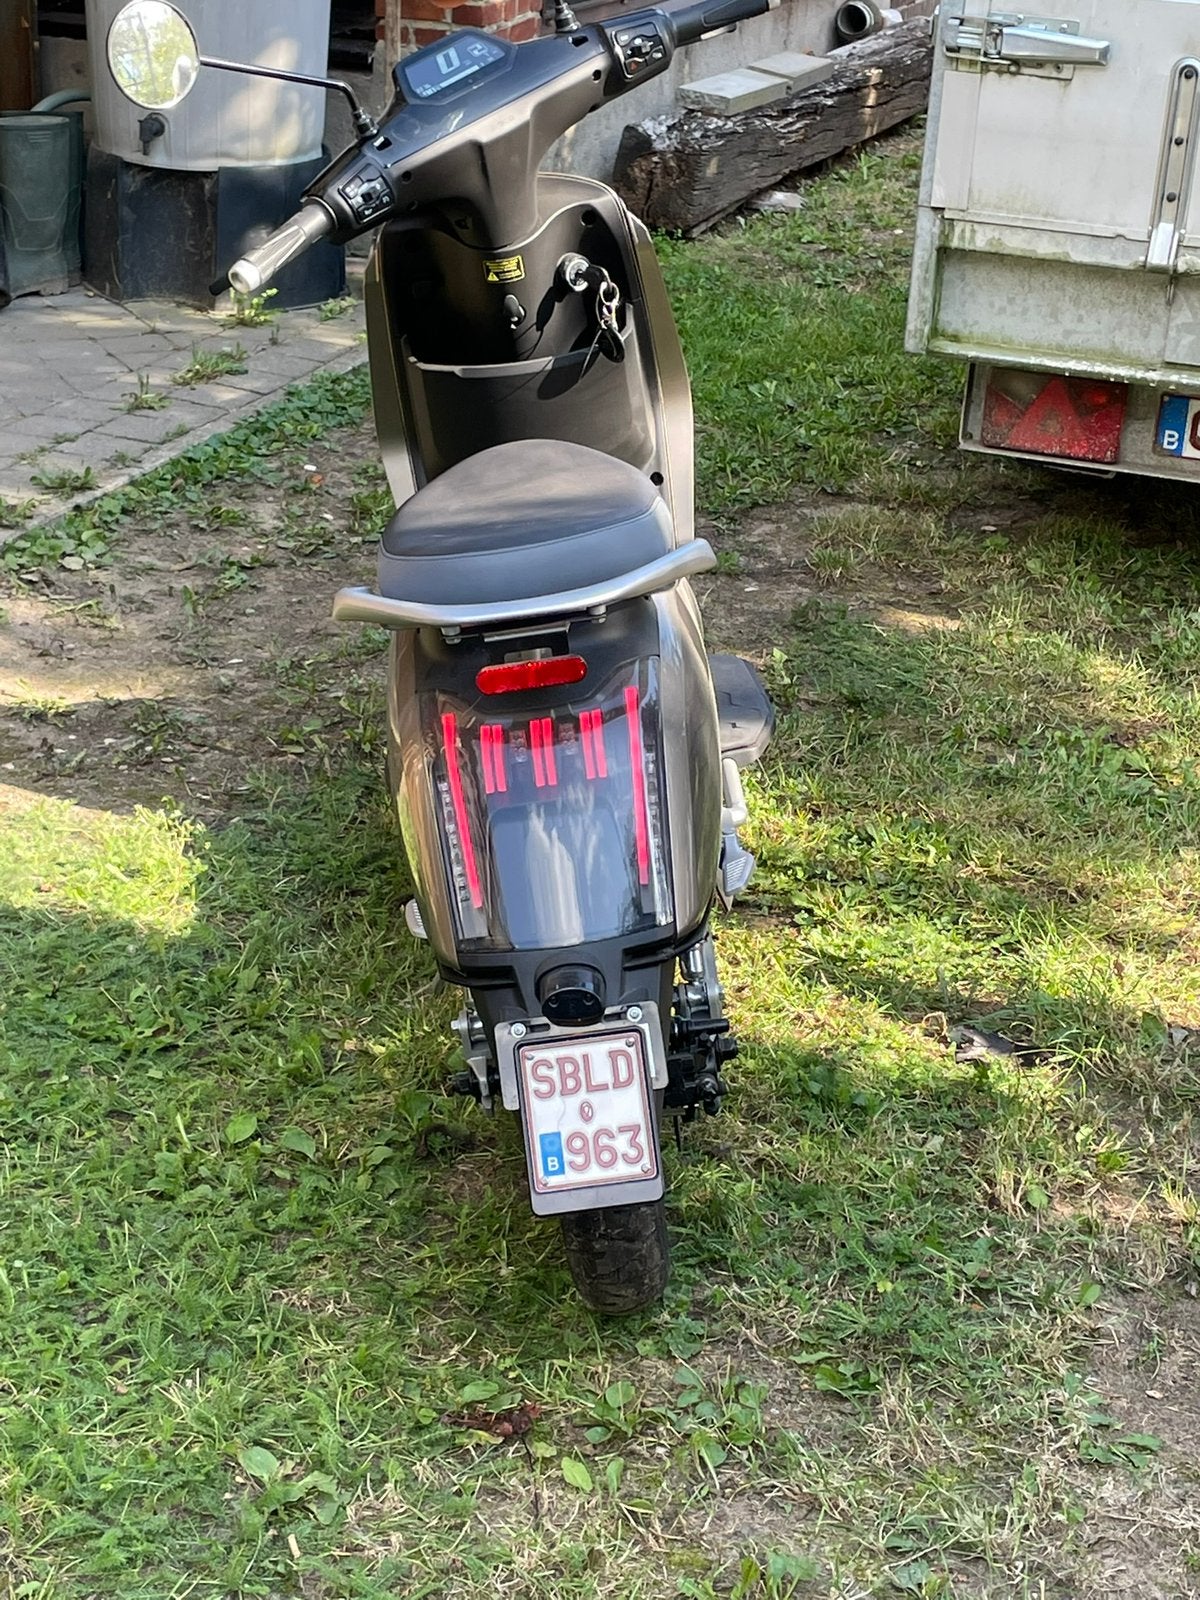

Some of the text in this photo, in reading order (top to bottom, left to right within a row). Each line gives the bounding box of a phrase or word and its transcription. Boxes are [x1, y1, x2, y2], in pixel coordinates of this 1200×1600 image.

[1163, 429, 1179, 450] B
[531, 1049, 634, 1099] SBLD
[547, 1124, 644, 1172] B 963
